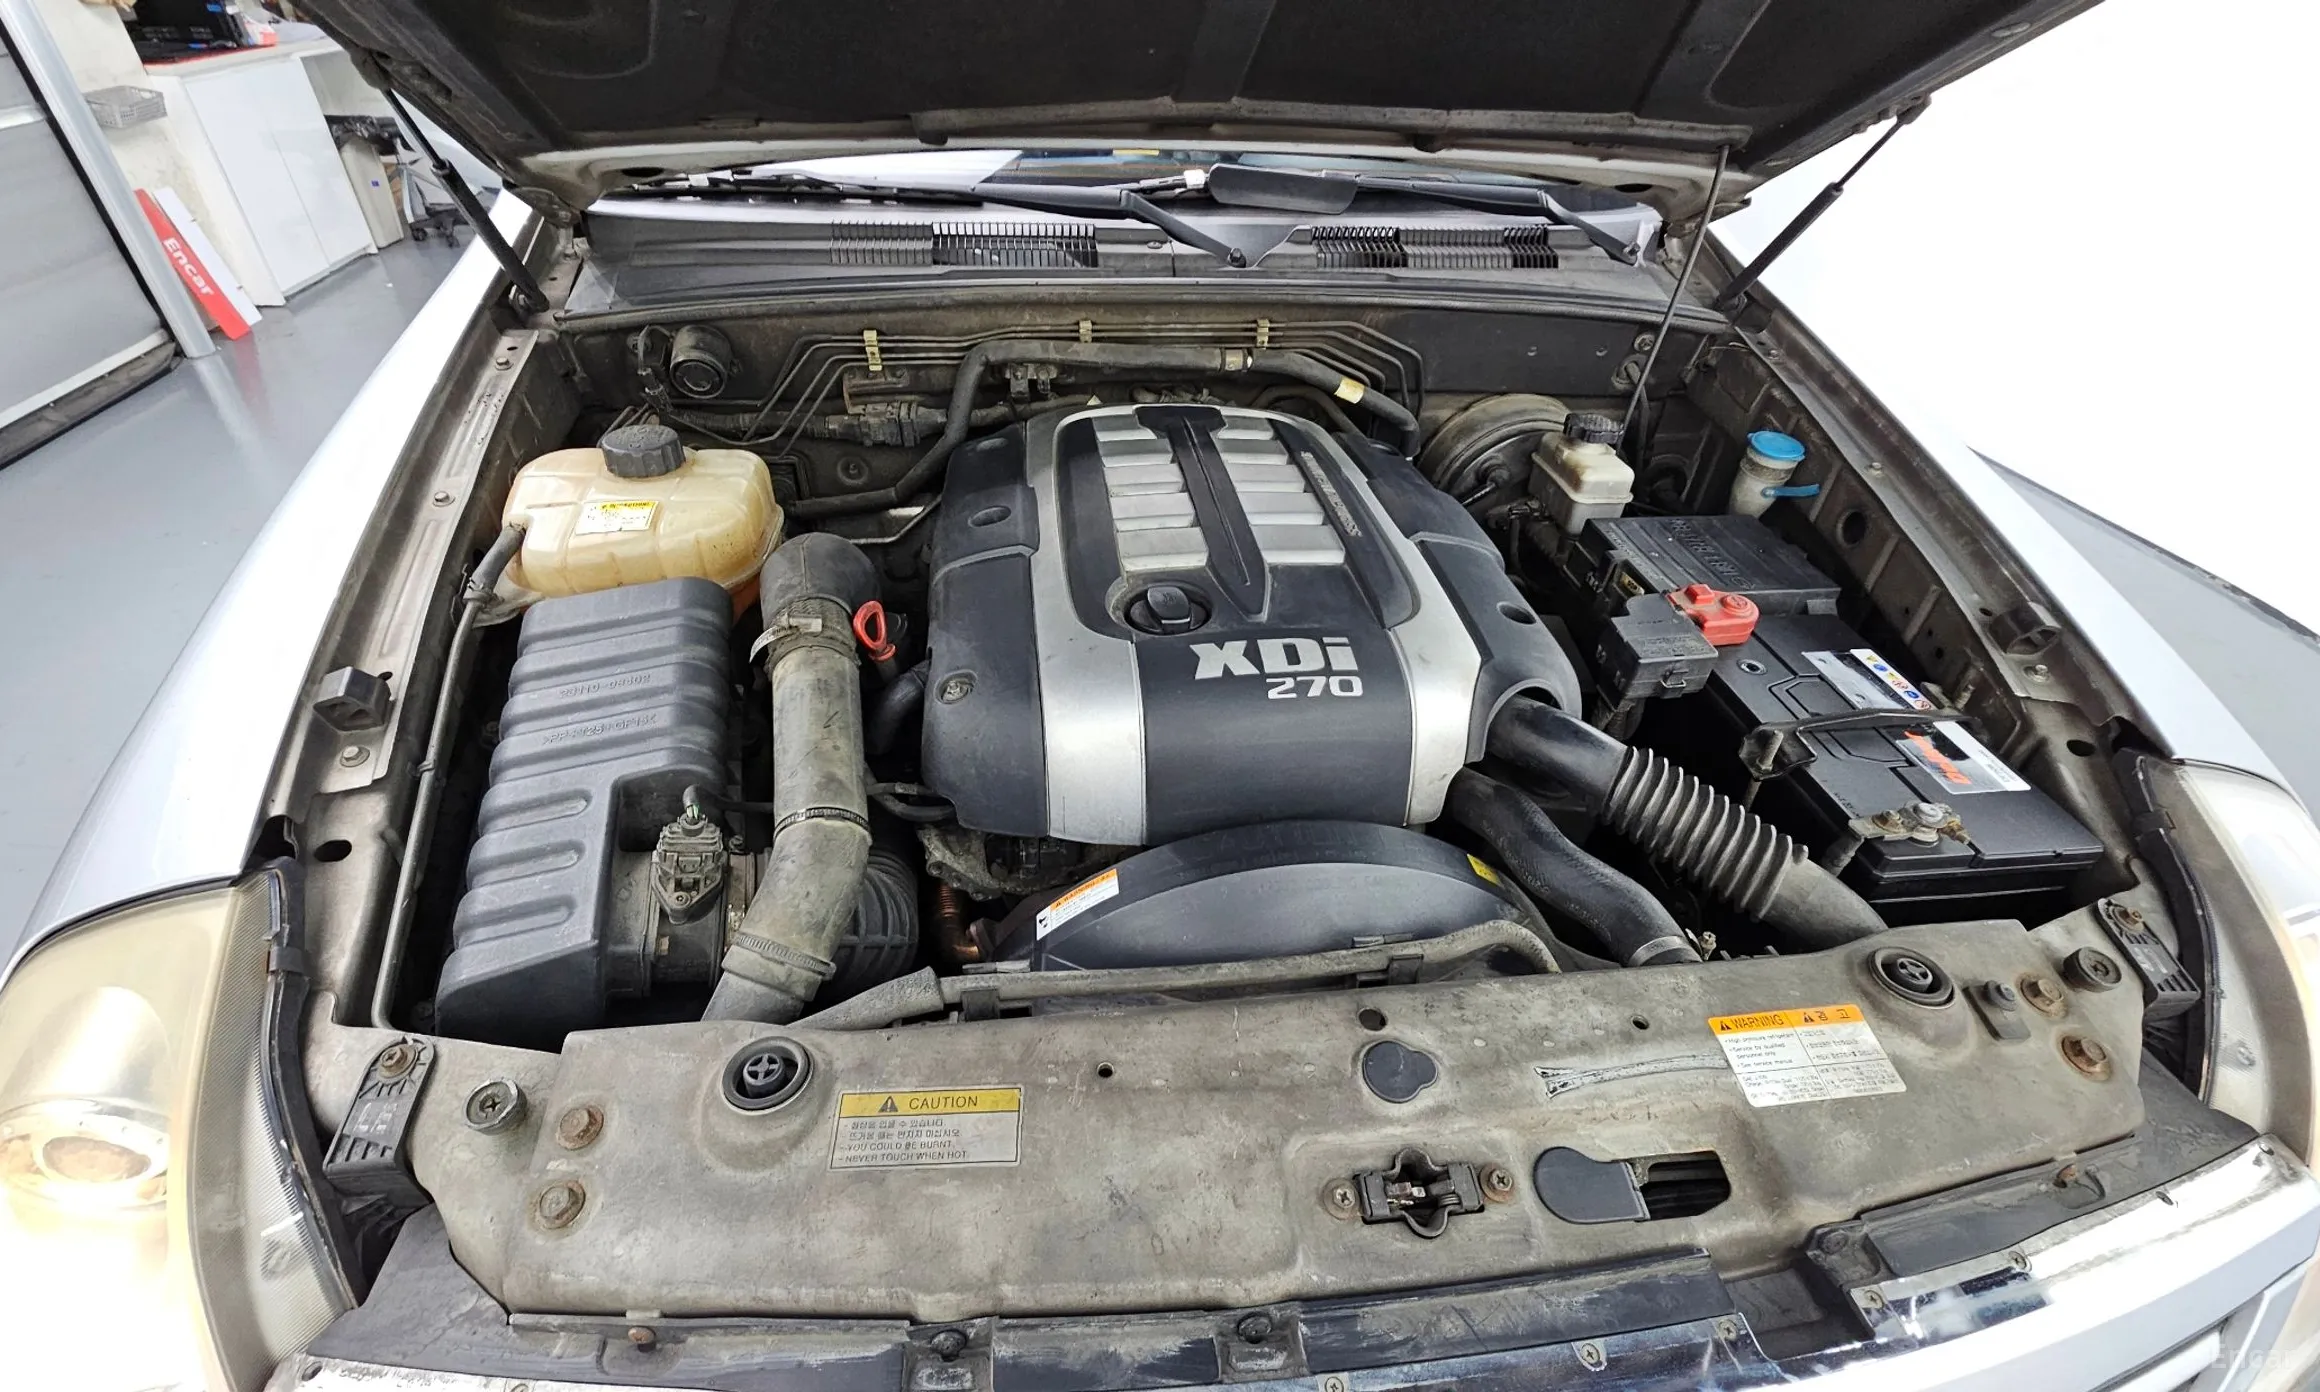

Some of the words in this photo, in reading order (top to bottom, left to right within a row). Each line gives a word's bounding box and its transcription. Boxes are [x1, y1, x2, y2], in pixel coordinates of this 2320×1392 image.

[163, 237, 215, 295] Encar
[1189, 636, 1359, 680] XDi
[1265, 675, 1364, 700] 270
[1730, 1014, 1784, 1029] WARNING
[1815, 1010, 1829, 1021] 경
[1836, 1008, 1851, 1019] 고
[909, 1095, 978, 1110] CAUTION
[847, 1143, 868, 1152] YOU
[869, 1142, 903, 1151] COULD
[905, 1141, 917, 1150] BE
[845, 1154, 878, 1163] NEVER
[880, 1152, 914, 1162] TOUCH
[915, 1151, 945, 1161] WHEN
